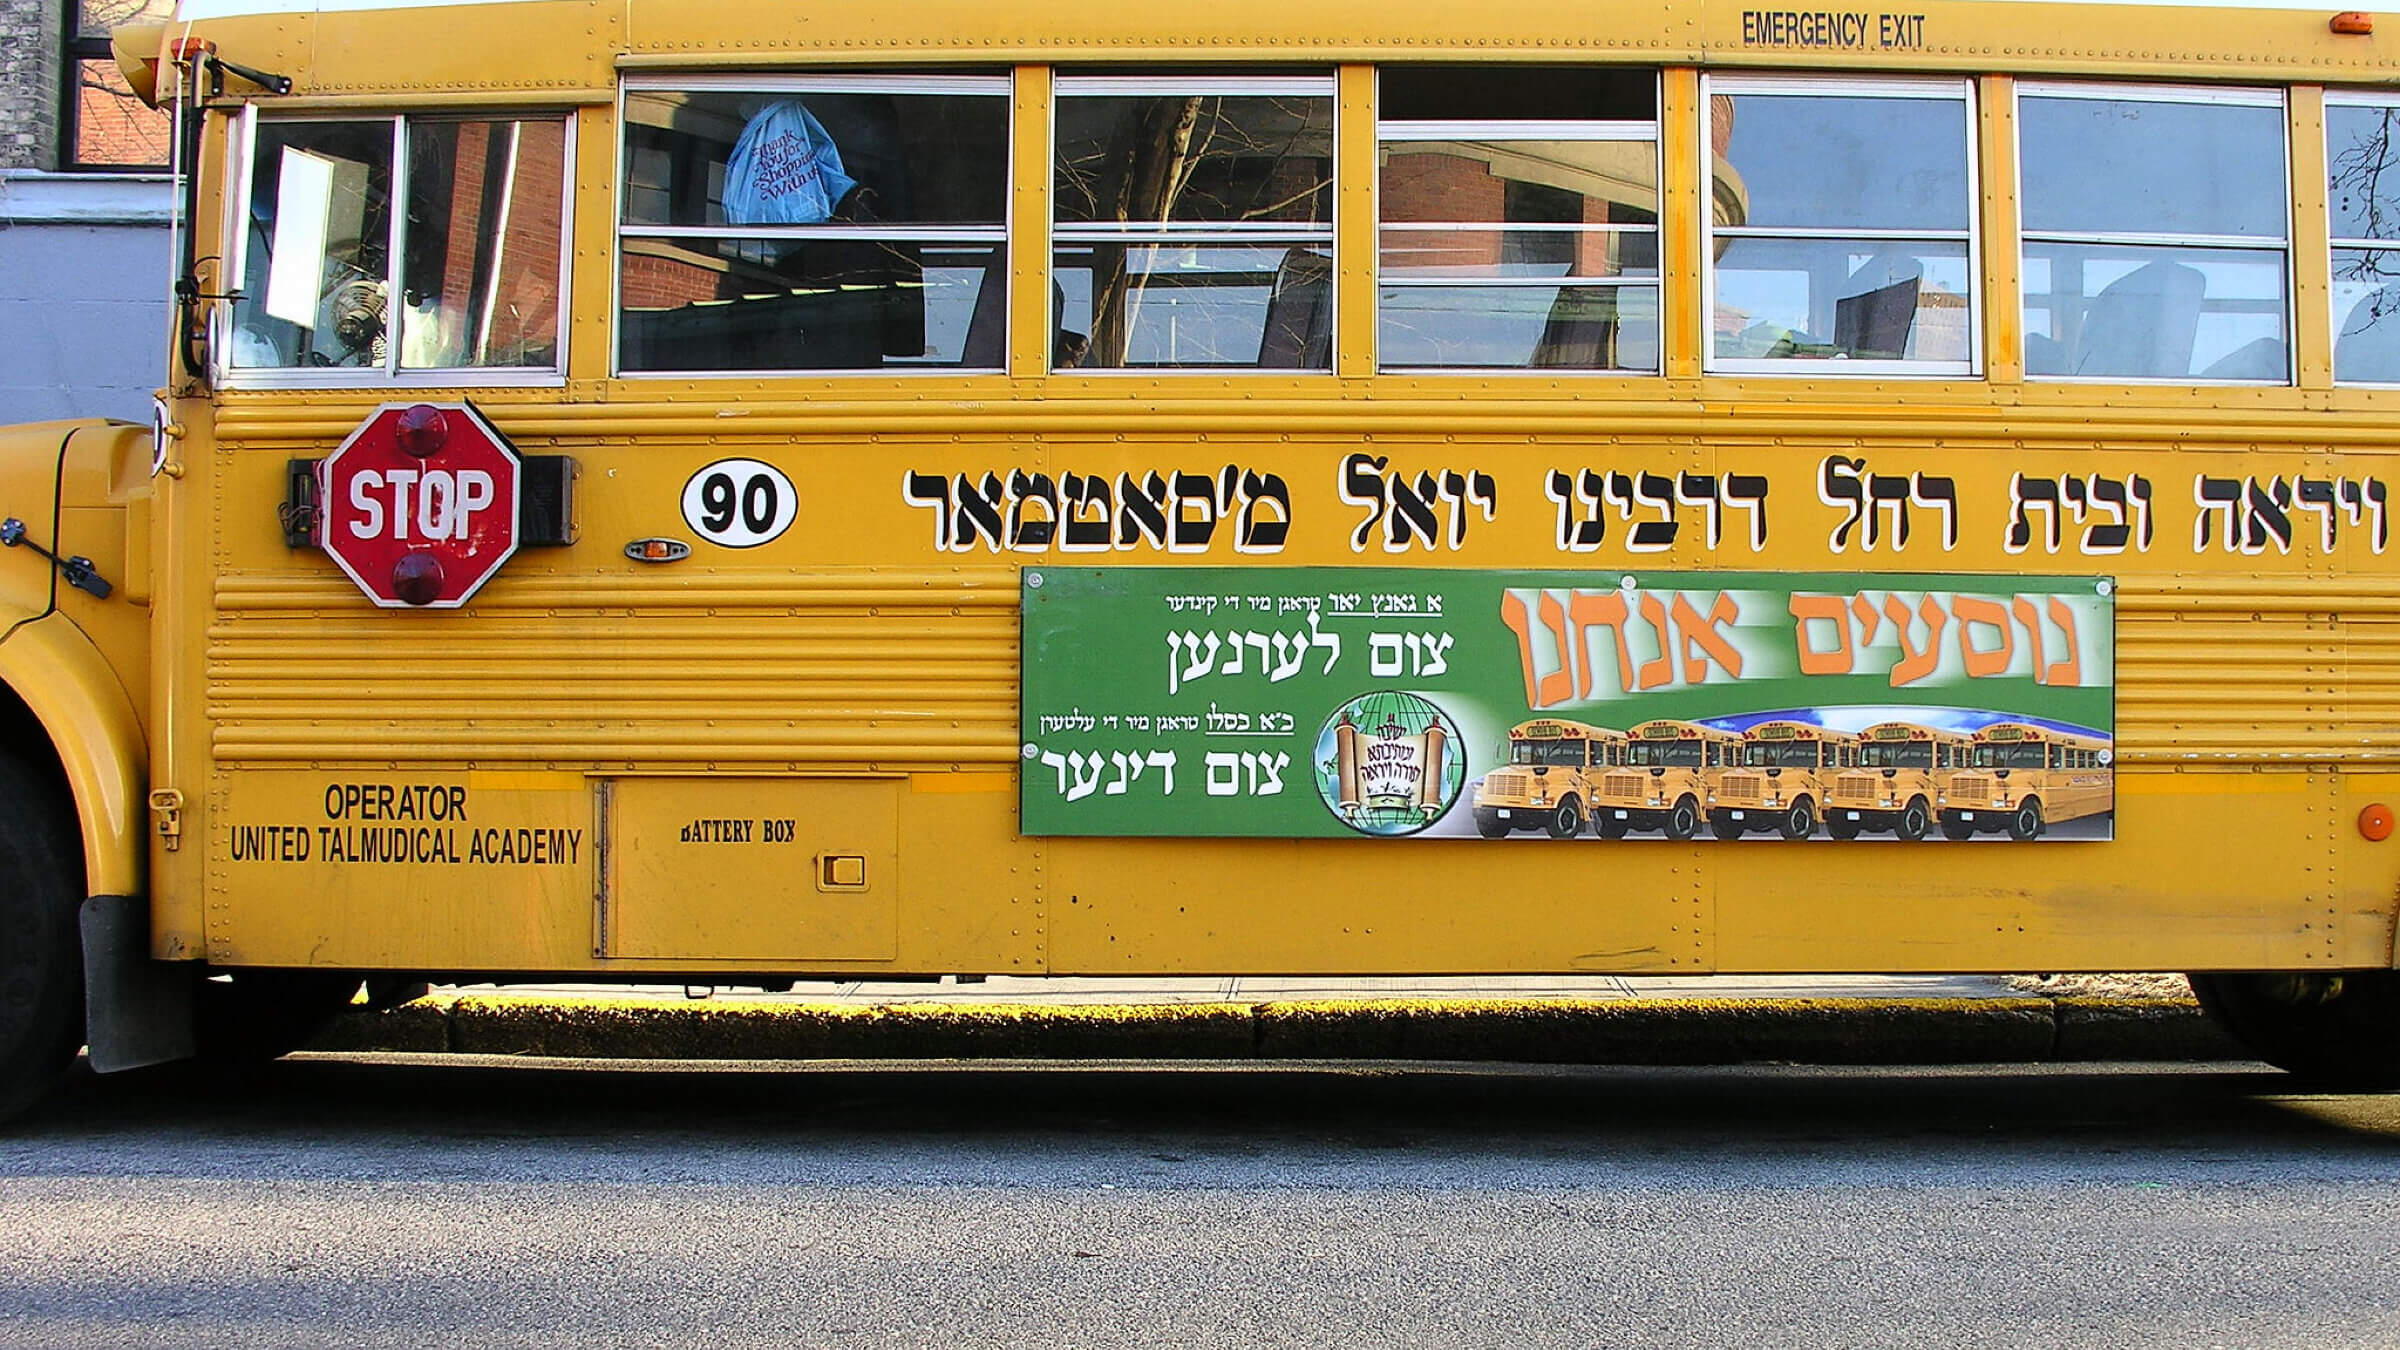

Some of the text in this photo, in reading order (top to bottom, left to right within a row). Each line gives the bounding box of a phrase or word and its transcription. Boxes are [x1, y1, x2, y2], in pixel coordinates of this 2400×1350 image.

[1742, 11, 1926, 48] EMERGENCY EXIT
[782, 142, 802, 166] for
[760, 173, 807, 201] With
[350, 469, 494, 540] STOP
[701, 472, 778, 534] 90
[1338, 453, 1496, 552] יואל
[1544, 467, 1768, 552] דרבינו
[1816, 454, 1958, 552] רחל
[2003, 471, 2153, 555] ובית
[2193, 473, 2388, 555] ויראה
[1166, 593, 1442, 617] א גאנץ יאר טראגן מיר די קינדער
[1166, 610, 1454, 695] צום לערנען
[1501, 588, 2081, 711] נוסעים אנחנו
[1039, 706, 1096, 736] עלטערן
[1102, 714, 1118, 731] די
[1125, 714, 1149, 731] מיר
[1156, 714, 1199, 736] טראגן
[1204, 701, 1251, 731] כסלו
[1040, 749, 1291, 802] צום דינער
[325, 784, 467, 821] OPERATOR
[231, 825, 582, 864] UNITED TALMUDICAL ACADEMY
[763, 820, 796, 843] BOX
